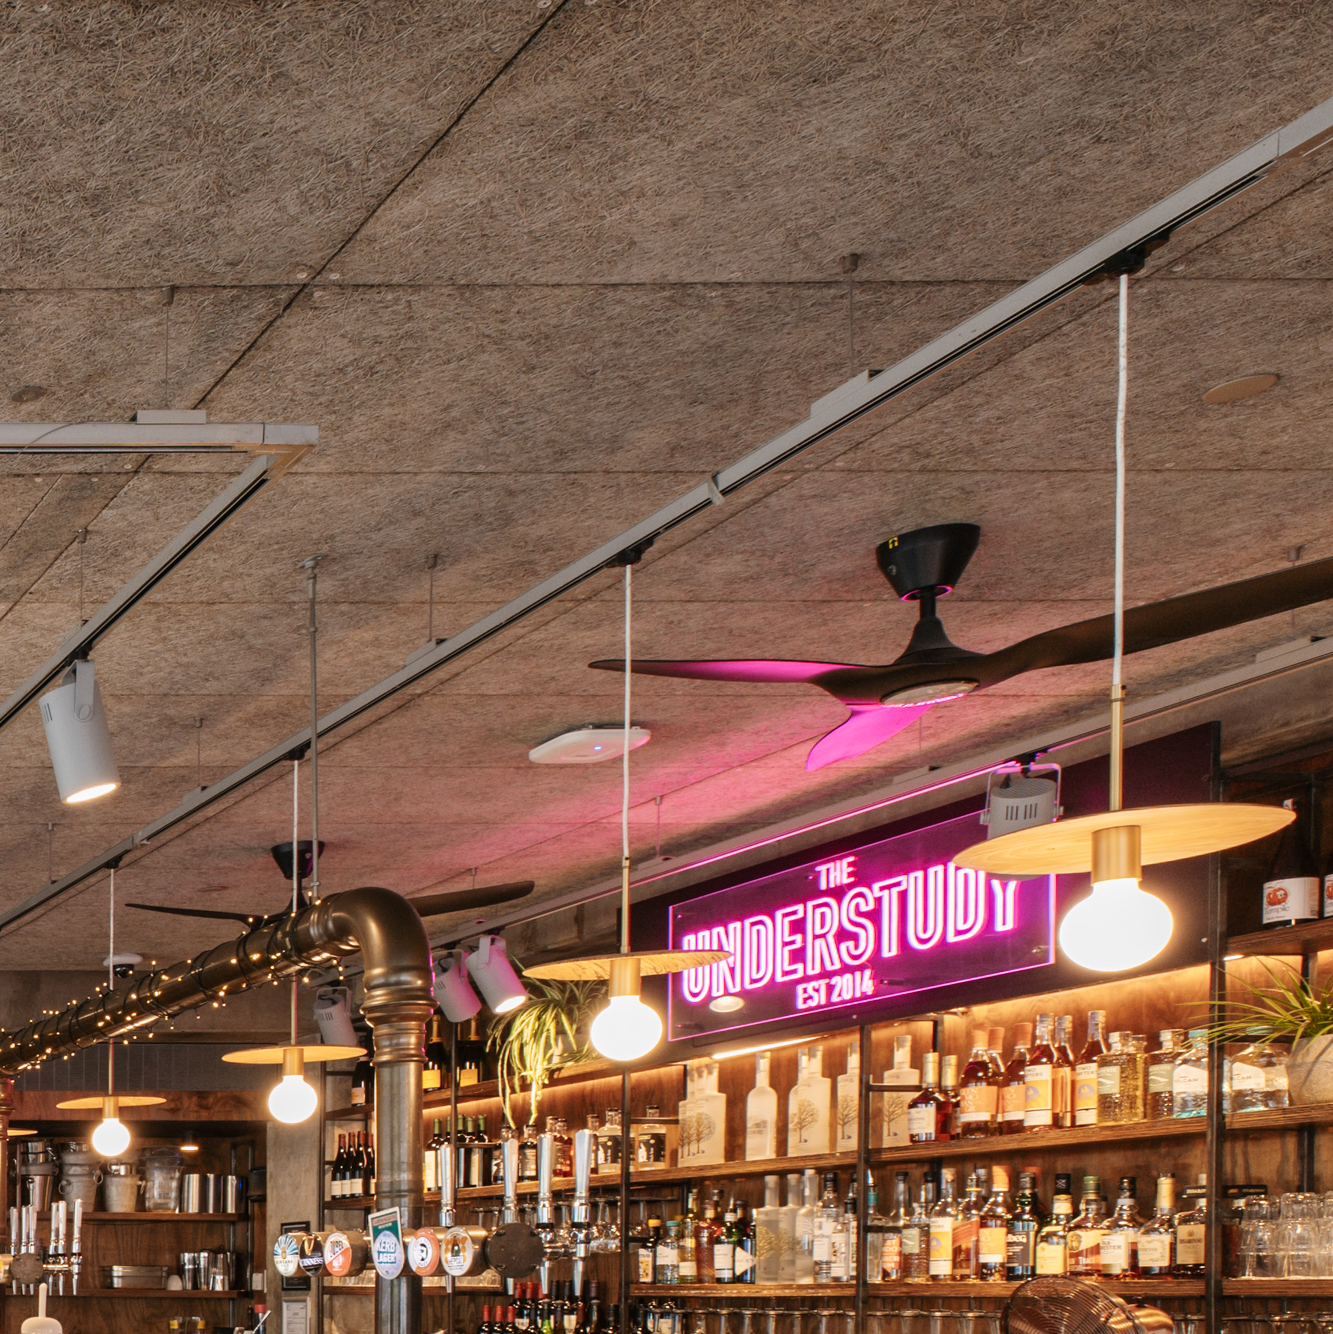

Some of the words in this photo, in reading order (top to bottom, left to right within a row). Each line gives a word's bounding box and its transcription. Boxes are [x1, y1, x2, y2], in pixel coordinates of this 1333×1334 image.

[814, 856, 858, 890] THE
[682, 862, 1022, 1003] UNDERSTUDY
[796, 974, 829, 1010] EST
[830, 968, 876, 1003] 2014
[377, 1239, 396, 1253] KERB
[377, 1252, 396, 1264] LAGER
